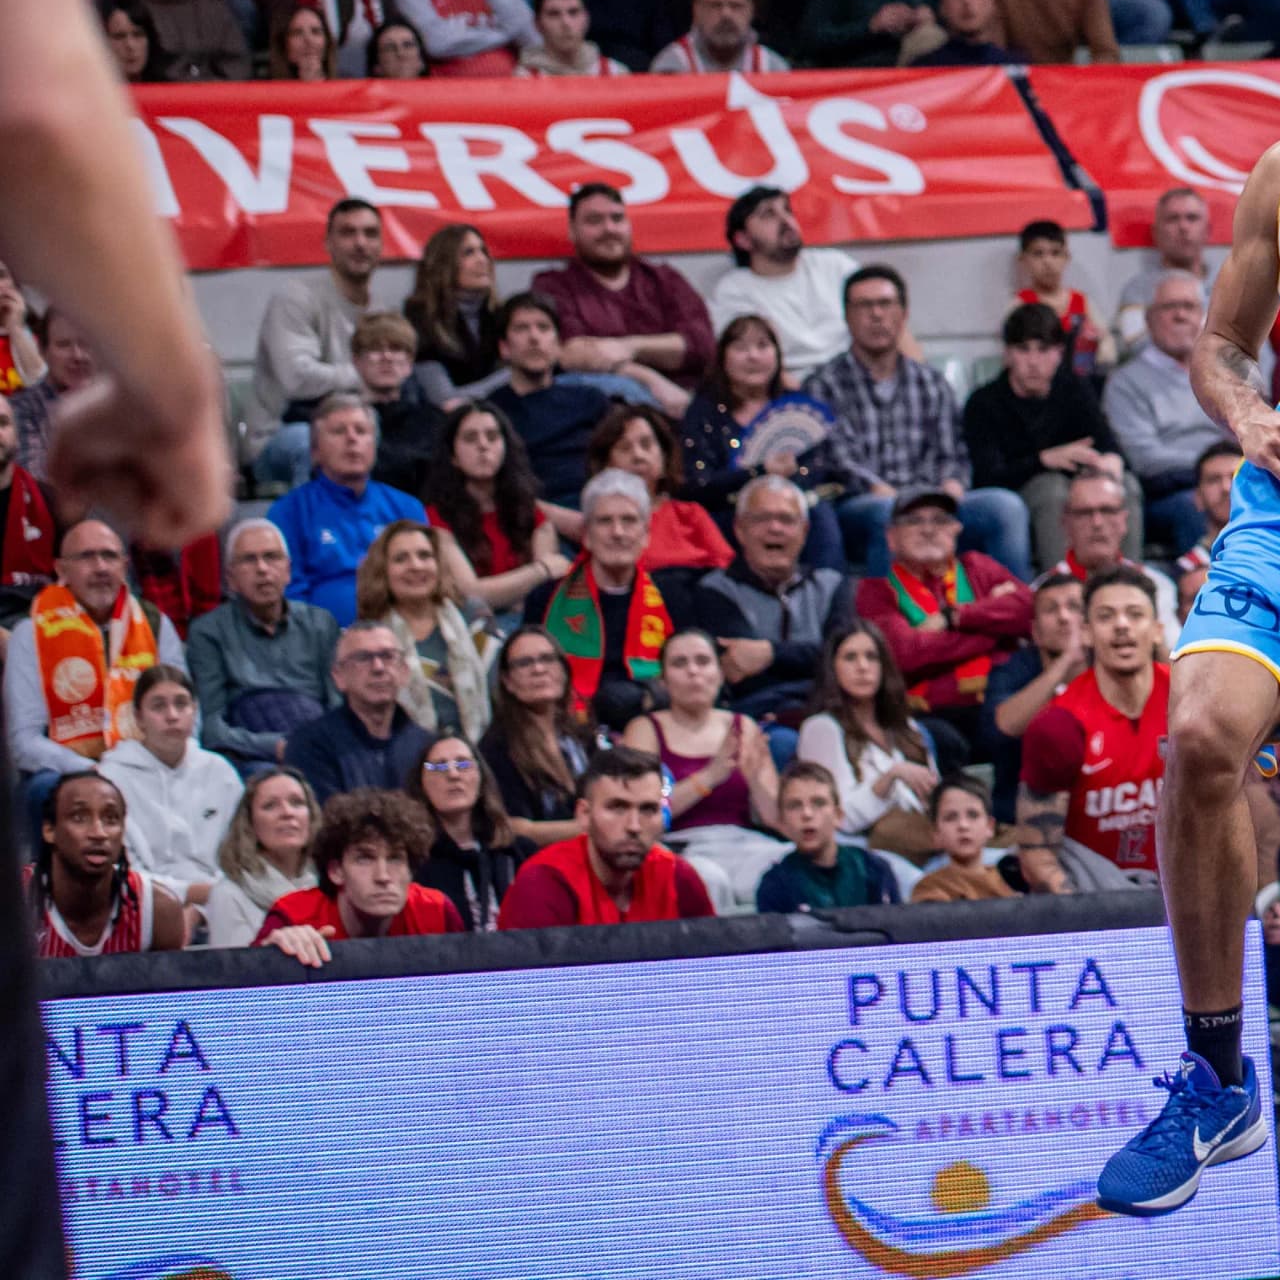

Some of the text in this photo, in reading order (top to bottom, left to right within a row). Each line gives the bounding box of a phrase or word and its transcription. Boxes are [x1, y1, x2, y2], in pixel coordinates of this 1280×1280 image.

[847, 958, 1118, 1027] PUNTA
[48, 1019, 212, 1080] NTA
[826, 1021, 1147, 1093] CALERA
[78, 1085, 241, 1149] ERA
[915, 1101, 1147, 1140] APARTAHOTEL
